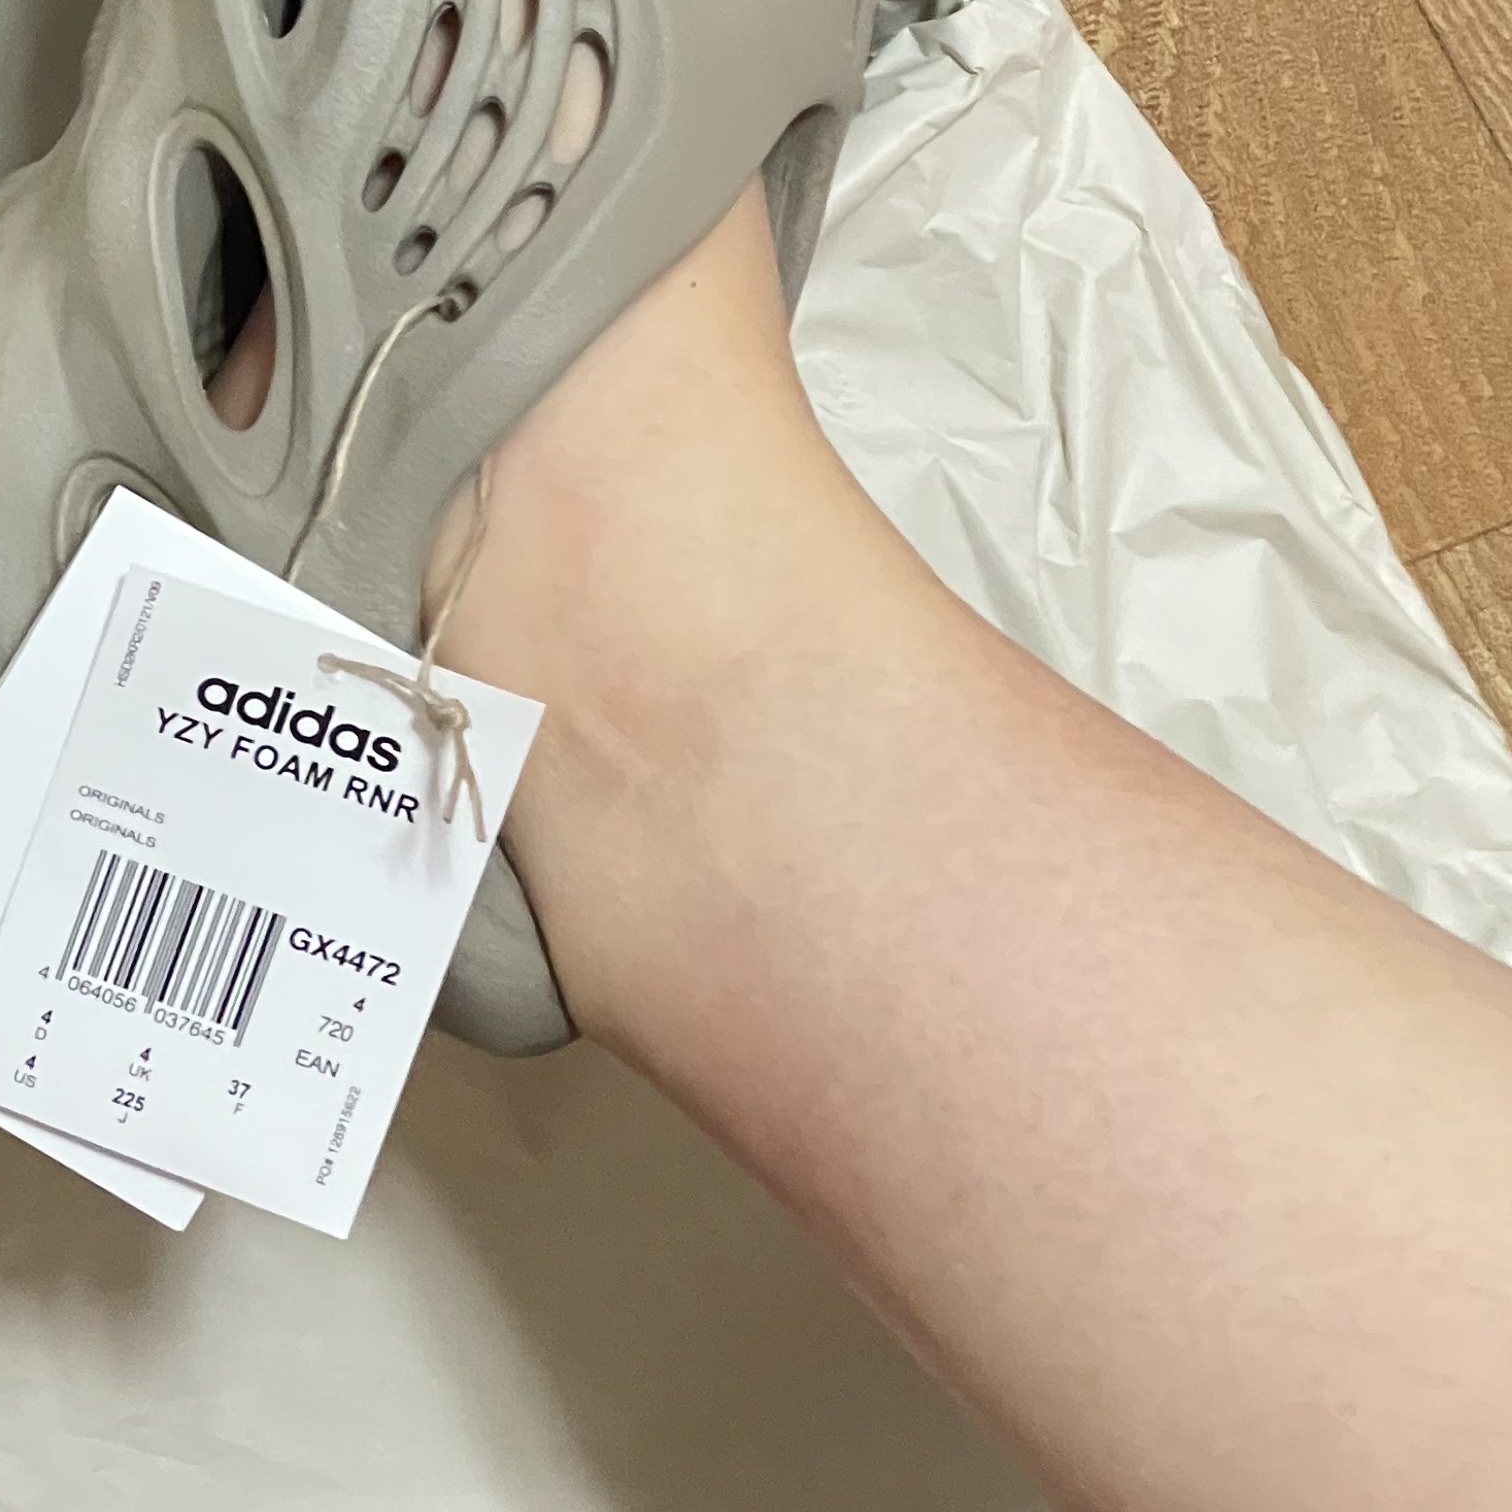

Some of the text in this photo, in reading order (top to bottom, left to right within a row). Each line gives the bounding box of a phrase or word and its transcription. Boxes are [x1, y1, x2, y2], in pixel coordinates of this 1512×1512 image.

[197, 677, 402, 772] adidas
[157, 706, 419, 823] YZY FOAM RNR
[78, 785, 165, 824] ORIGINALS
[70, 809, 156, 847] ORIGINALS
[289, 927, 401, 986] GX4472
[38, 966, 226, 1045] 4 064056 037645
[352, 997, 366, 1013] 4
[41, 1010, 53, 1024] 4
[35, 1026, 47, 1040] D
[318, 1015, 354, 1042] 720
[24, 1055, 37, 1069] 4
[140, 1047, 152, 1063] 4
[295, 1048, 340, 1077] EAN
[13, 1069, 37, 1088] US
[128, 1063, 152, 1081] UK
[111, 1088, 146, 1112] 225
[227, 1079, 251, 1099] 37
[233, 1102, 245, 1114] F
